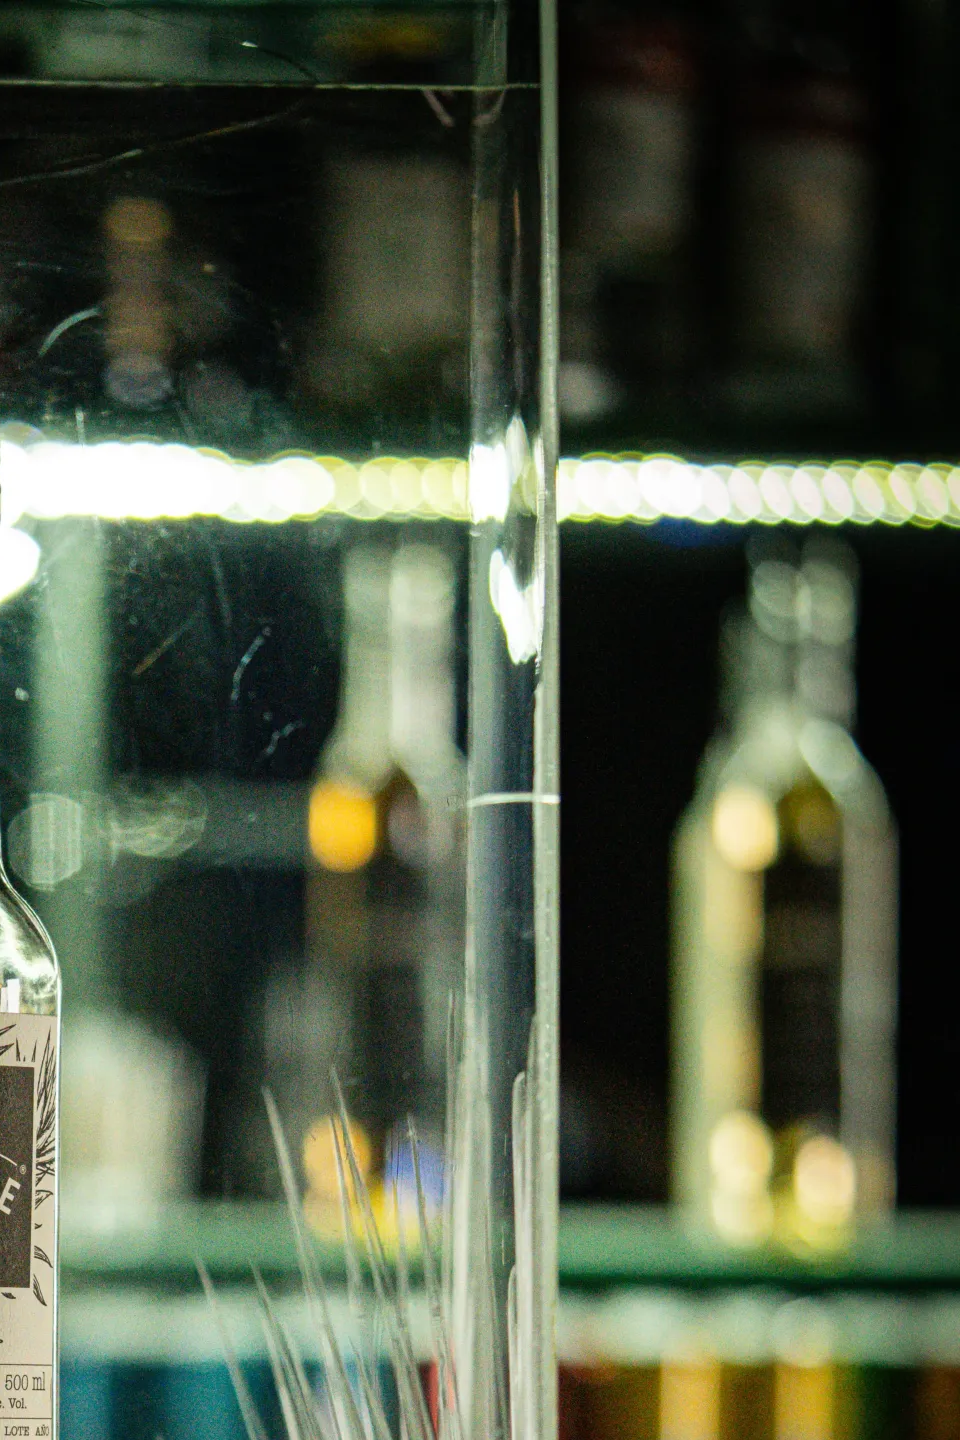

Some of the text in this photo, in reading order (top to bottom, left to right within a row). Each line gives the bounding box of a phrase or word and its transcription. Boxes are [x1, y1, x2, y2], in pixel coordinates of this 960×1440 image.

[5, 1374, 29, 1391] 500
[32, 1371, 46, 1391] ml
[8, 1397, 27, 1409] Vol.
[5, 1425, 30, 1436] LOTE
